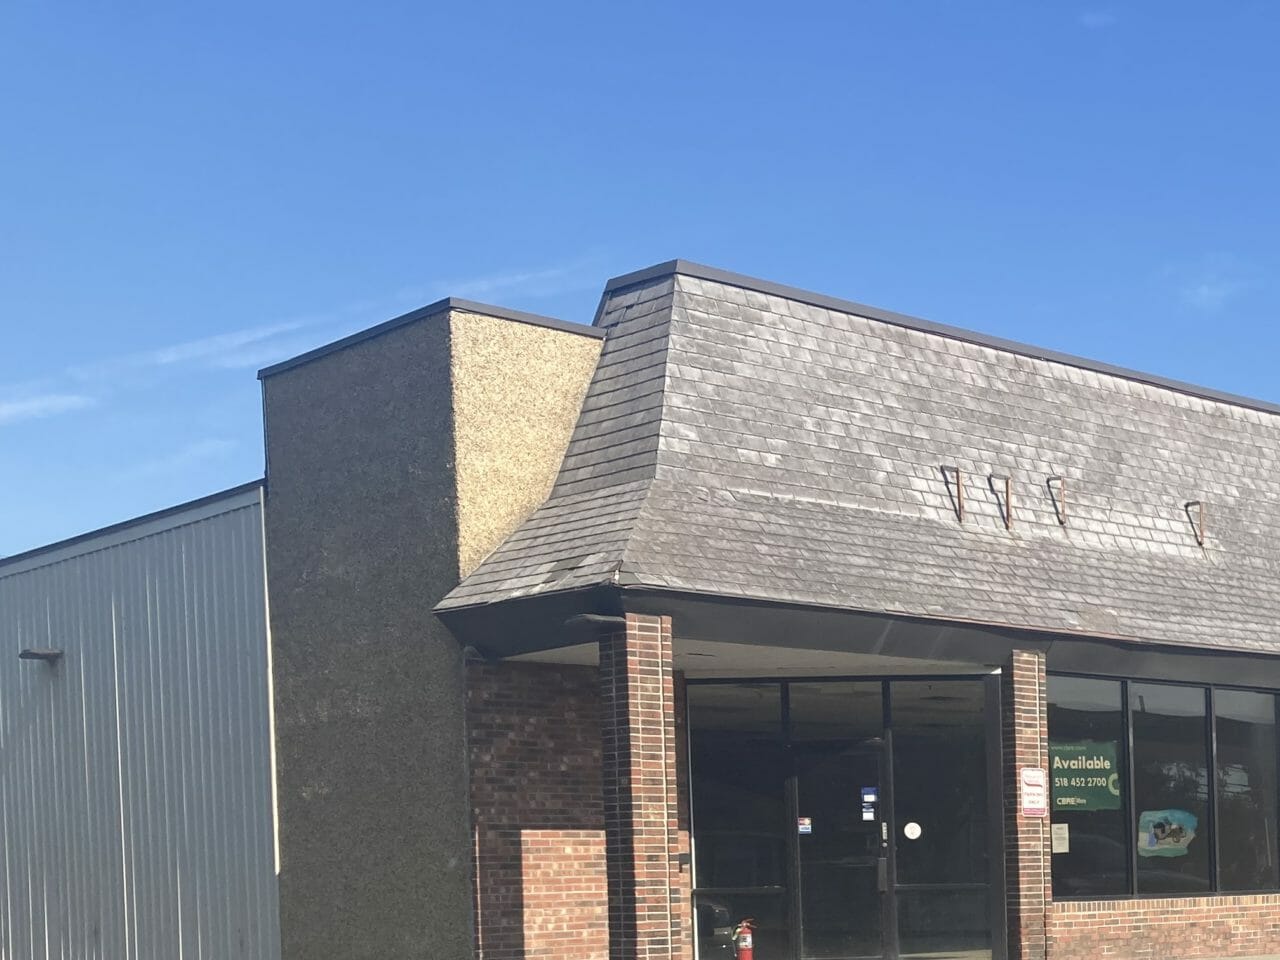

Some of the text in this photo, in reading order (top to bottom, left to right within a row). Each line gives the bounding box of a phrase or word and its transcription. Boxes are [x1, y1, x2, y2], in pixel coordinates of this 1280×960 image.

[1053, 756, 1111, 769] Available
[1055, 777, 1107, 787] 518 452 2700
